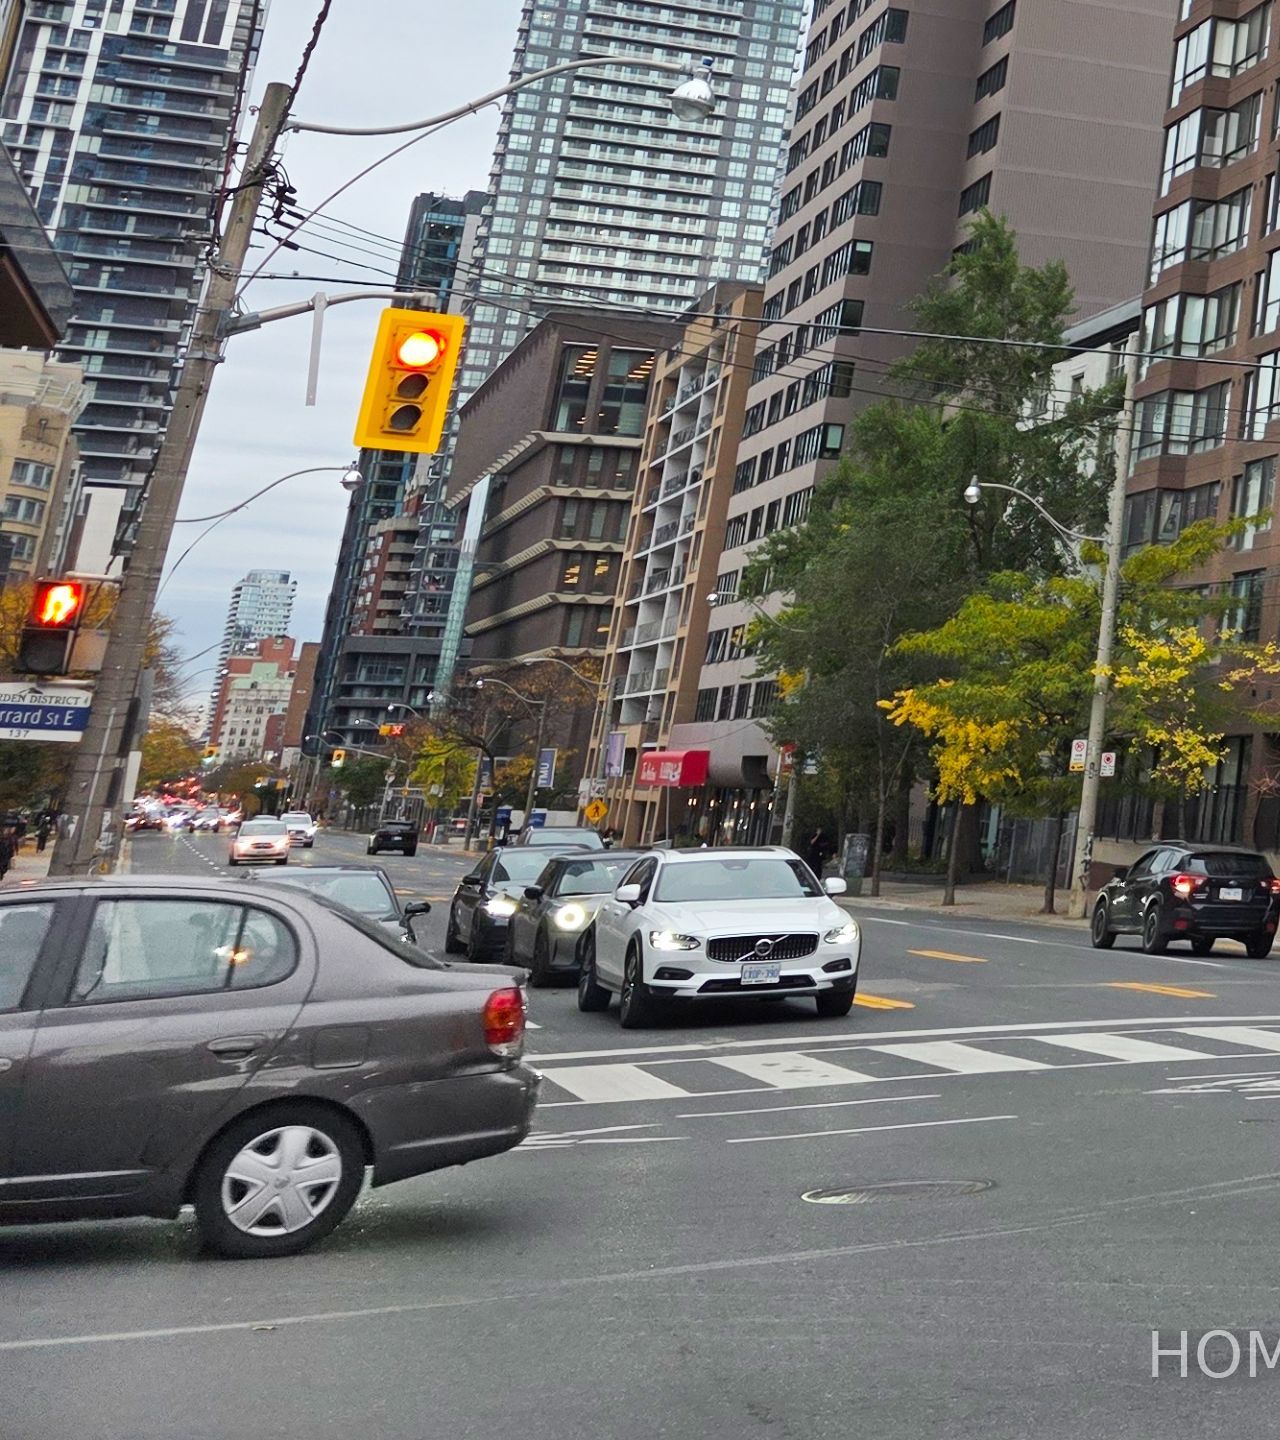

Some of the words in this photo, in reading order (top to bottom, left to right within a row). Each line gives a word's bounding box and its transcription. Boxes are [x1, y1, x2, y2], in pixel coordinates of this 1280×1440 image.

[30, 695, 80, 706] DISTRICT
[45, 712, 60, 726] St
[63, 710, 75, 726] E
[539, 762, 550, 785] TMU
